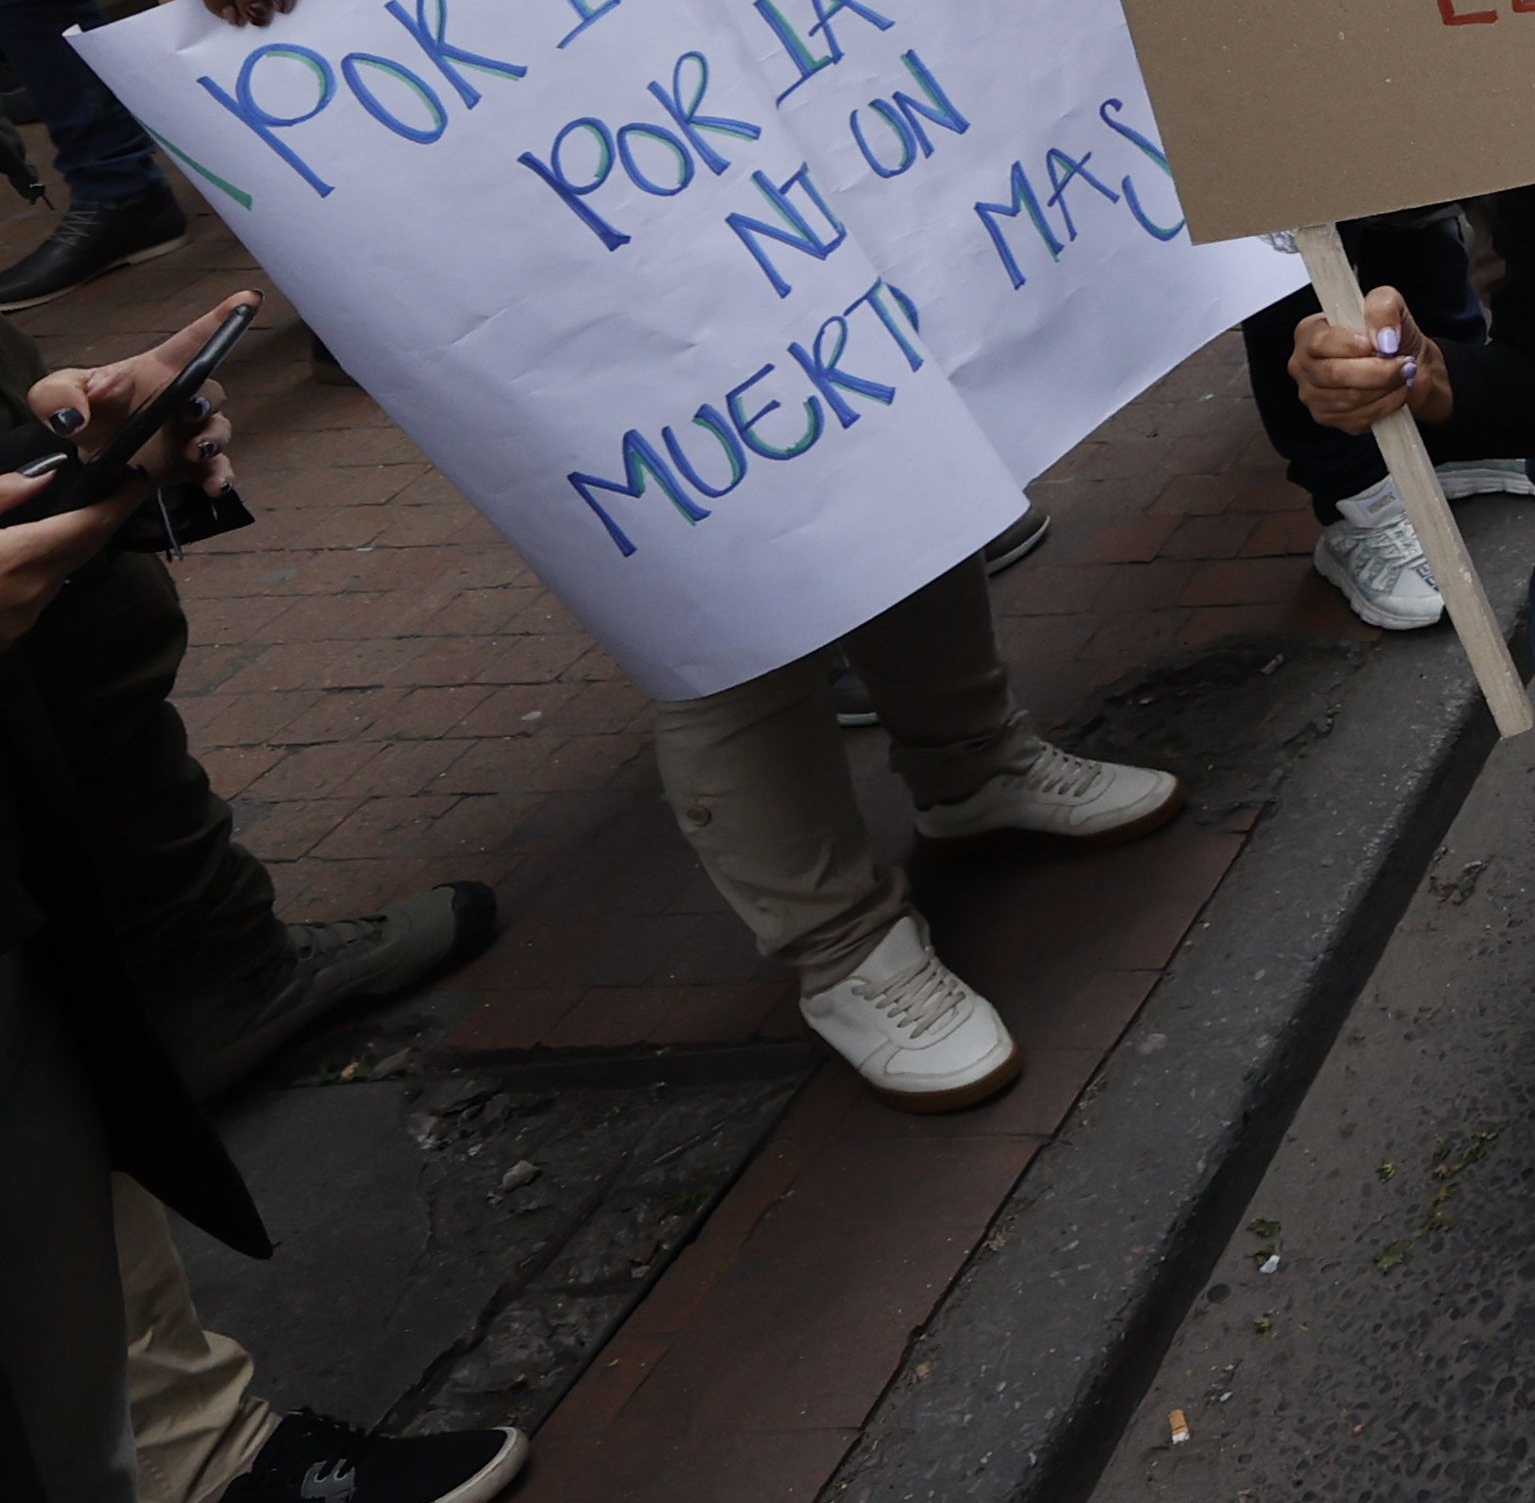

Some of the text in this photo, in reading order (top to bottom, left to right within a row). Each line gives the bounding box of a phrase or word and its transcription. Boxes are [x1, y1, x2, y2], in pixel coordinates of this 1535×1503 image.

[518, 50, 763, 252] POR
[725, 48, 971, 300] NI UN
